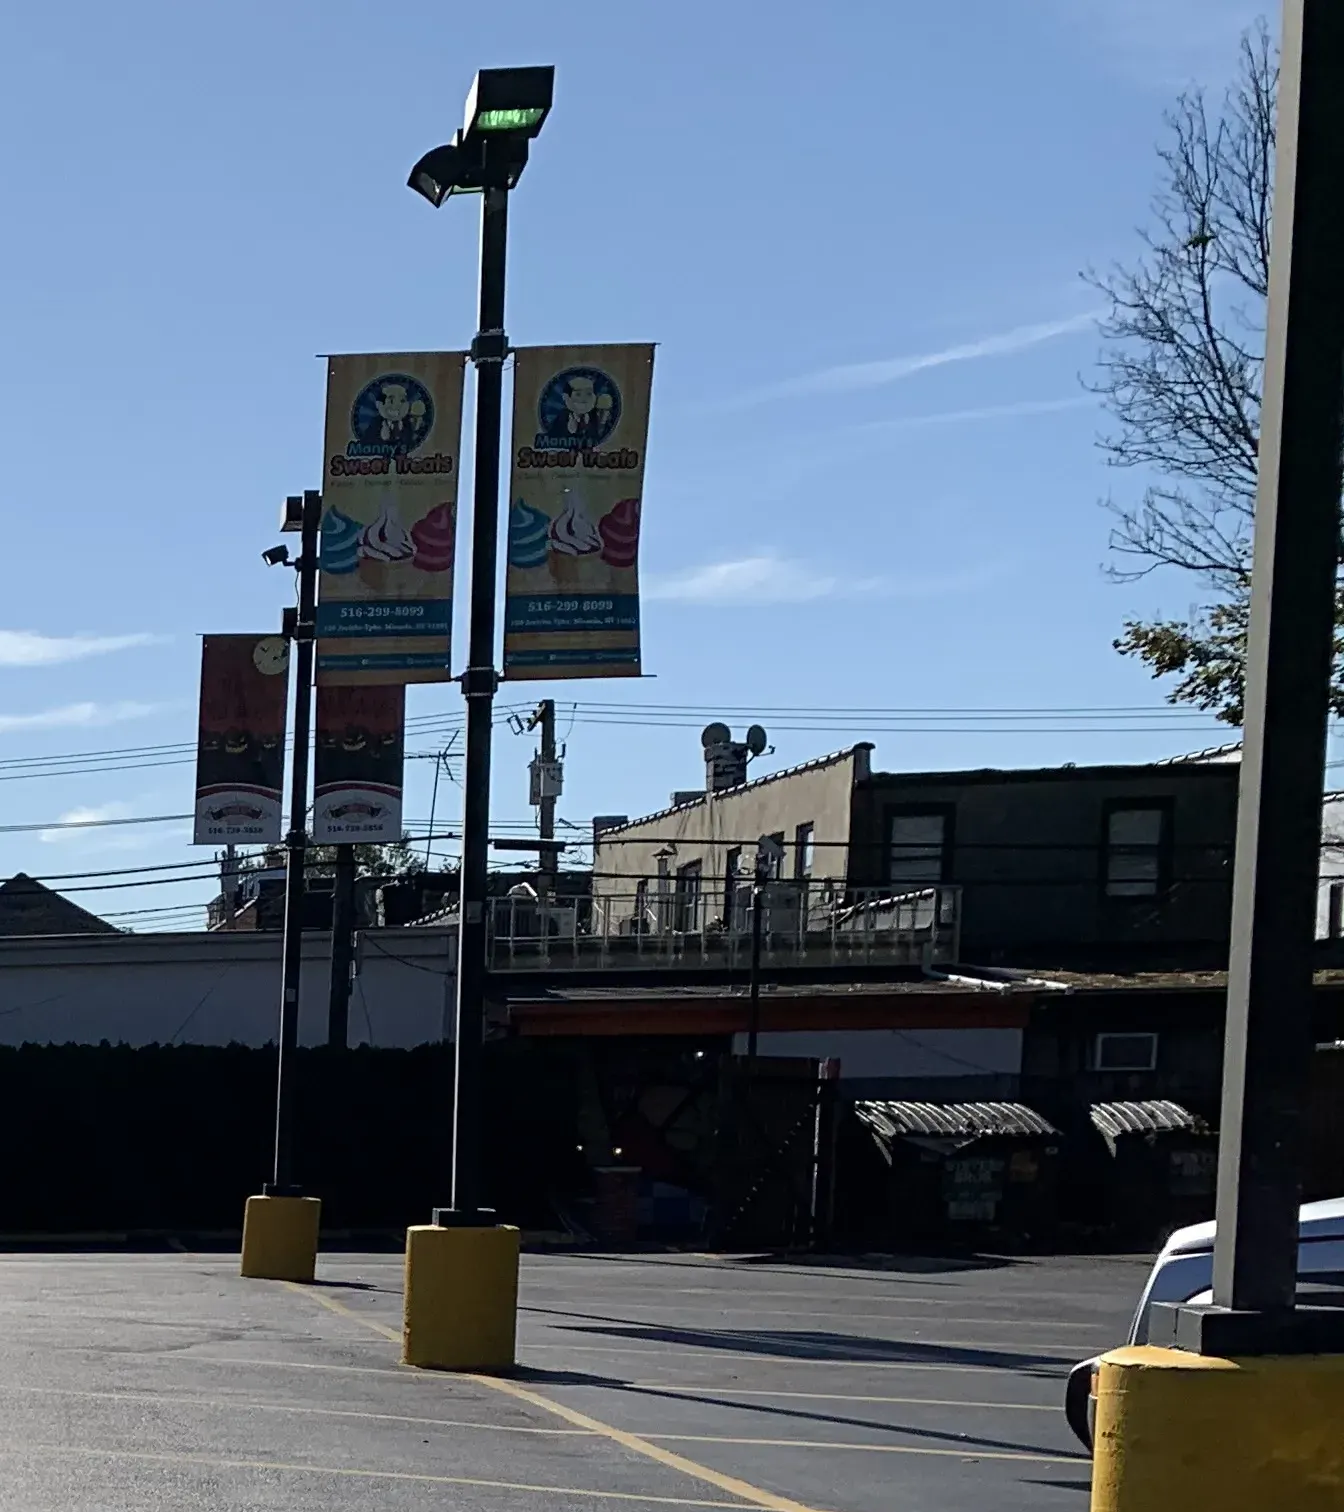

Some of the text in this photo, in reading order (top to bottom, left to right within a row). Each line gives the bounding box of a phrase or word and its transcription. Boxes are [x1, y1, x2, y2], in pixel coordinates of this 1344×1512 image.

[347, 441, 407, 457] Manny's
[536, 433, 596, 449] Manny's
[330, 453, 452, 476] Sweet Treats
[517, 446, 639, 468] Sweet Treats
